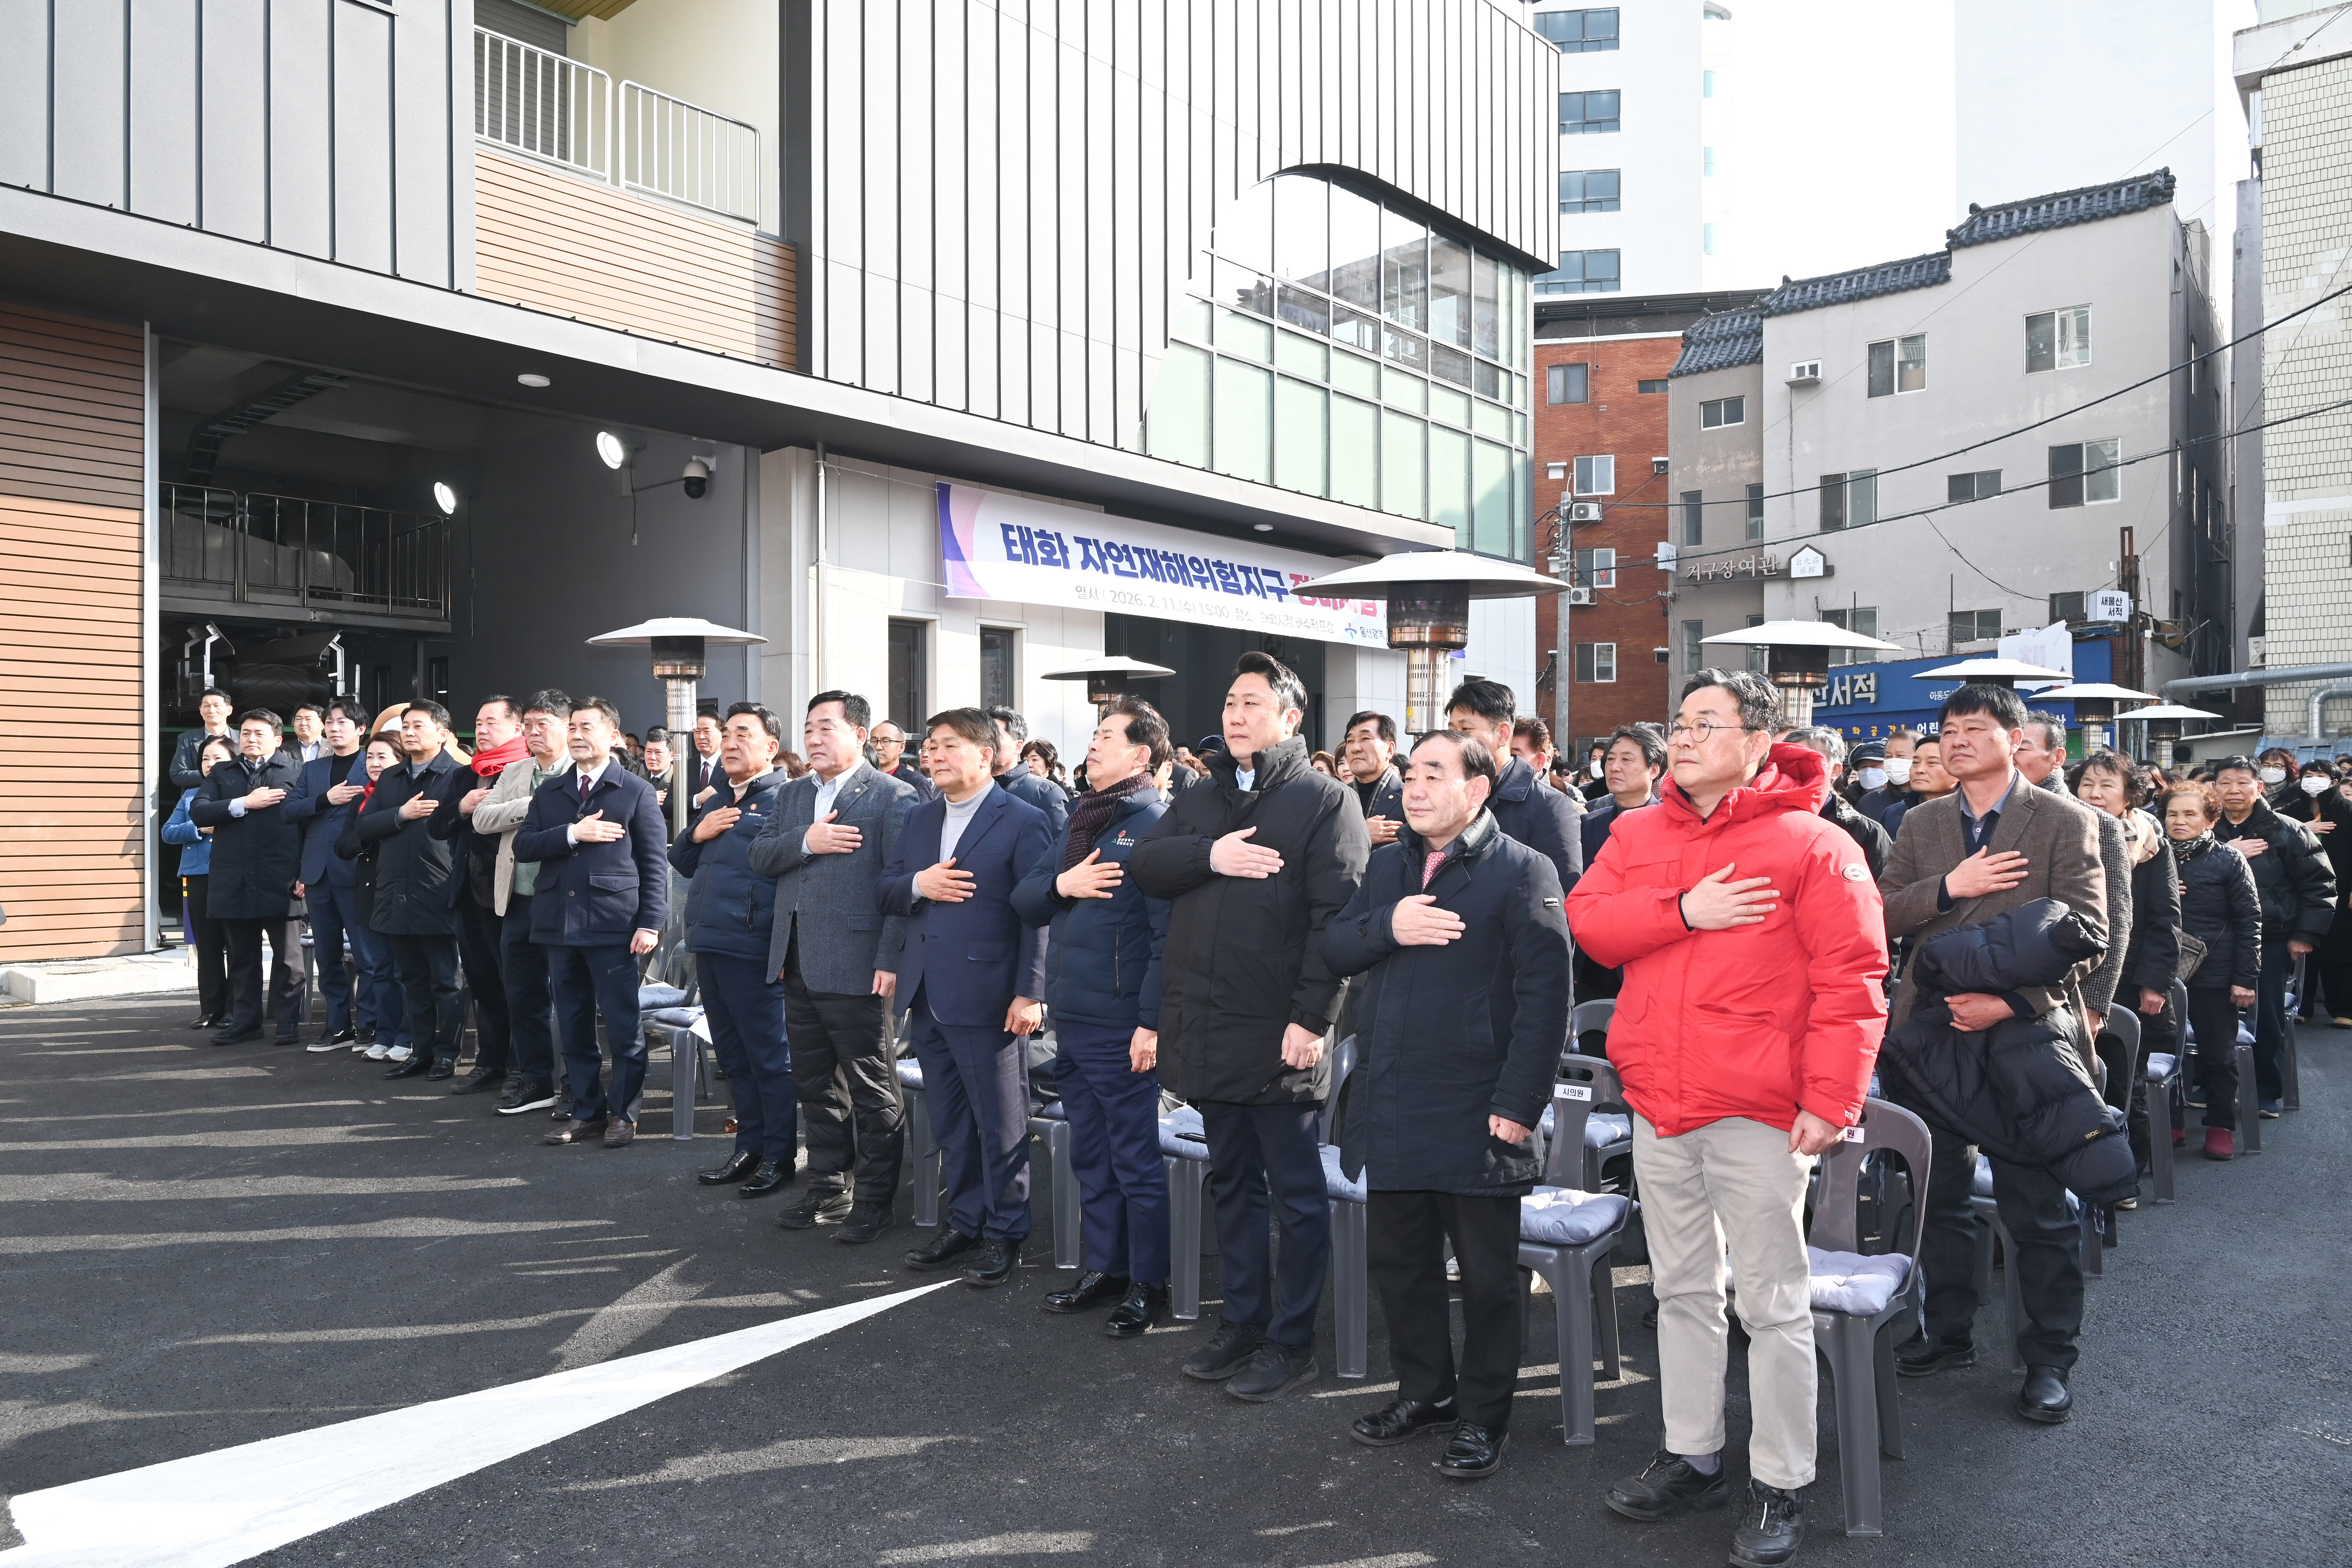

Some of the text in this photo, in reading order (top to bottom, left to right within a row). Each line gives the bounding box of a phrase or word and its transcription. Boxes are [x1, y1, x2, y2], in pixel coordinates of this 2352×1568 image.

[1000, 523, 1070, 570] 태화
[1073, 535, 1289, 603] 자연재해위험지구
[1075, 585, 1099, 601] 일시
[1198, 603, 1229, 618] 15:00
[2101, 596, 2123, 606] 새울산
[2108, 607, 2123, 617] 서적
[1359, 626, 1387, 640] 울산광역
[1562, 1088, 1584, 1098] 시의원
